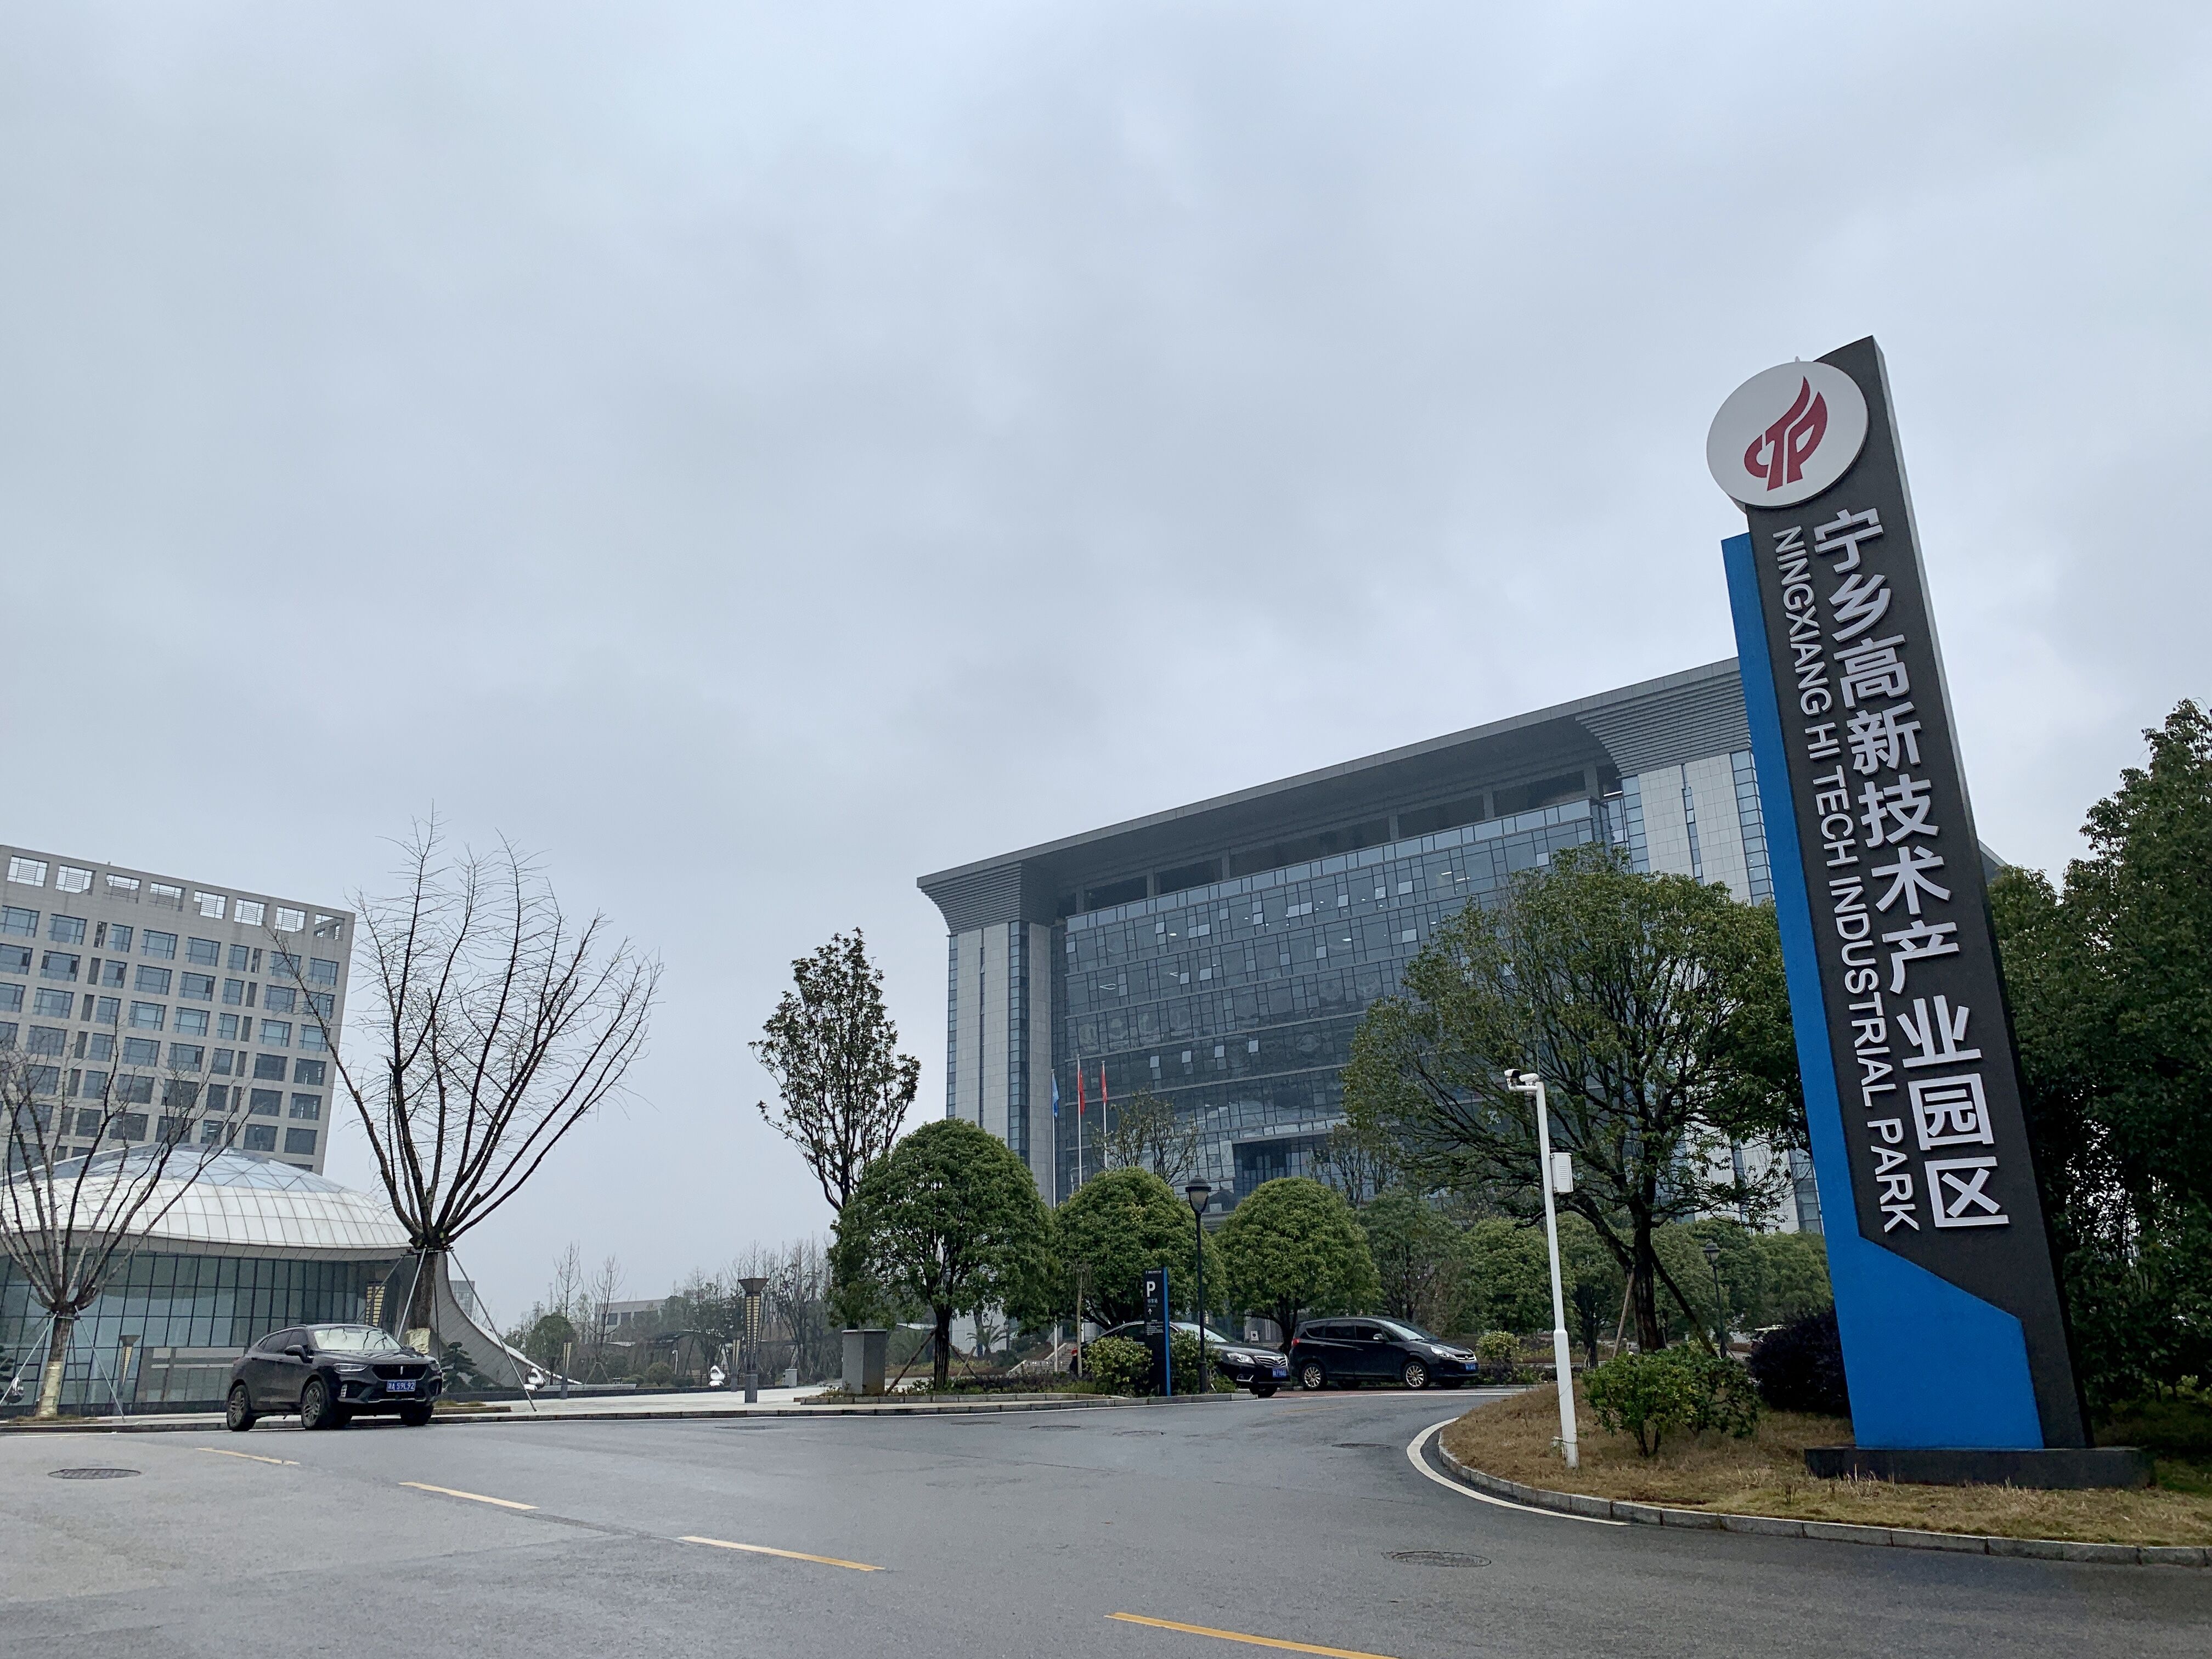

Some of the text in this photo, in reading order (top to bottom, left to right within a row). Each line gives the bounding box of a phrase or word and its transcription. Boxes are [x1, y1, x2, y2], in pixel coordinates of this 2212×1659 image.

[1772, 525, 1920, 1233] NINGXIANG HI TECH INDUSTRIAL PARK
[1813, 507, 2010, 1228] 宁乡高新技术产业园区
[1146, 1281, 1156, 1297] P
